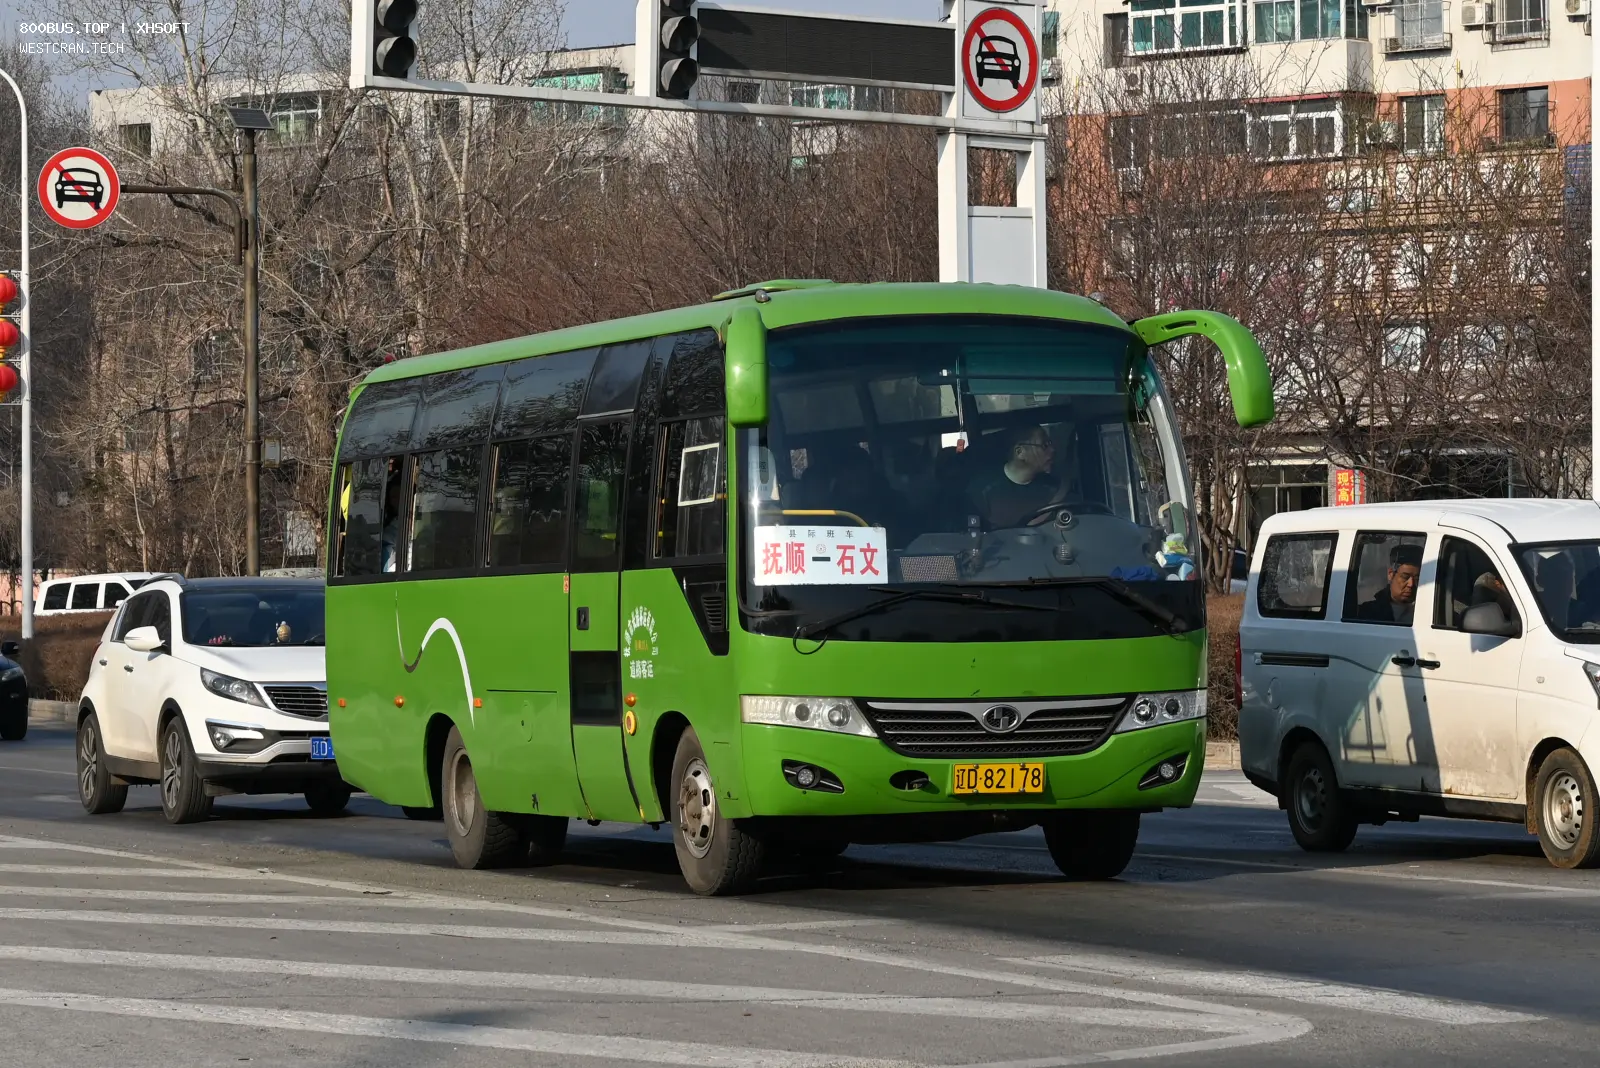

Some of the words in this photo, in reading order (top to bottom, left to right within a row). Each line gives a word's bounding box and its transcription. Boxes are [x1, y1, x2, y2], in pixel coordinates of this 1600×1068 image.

[789, 529, 854, 539] 县际班车
[629, 660, 654, 679] 道路客运
